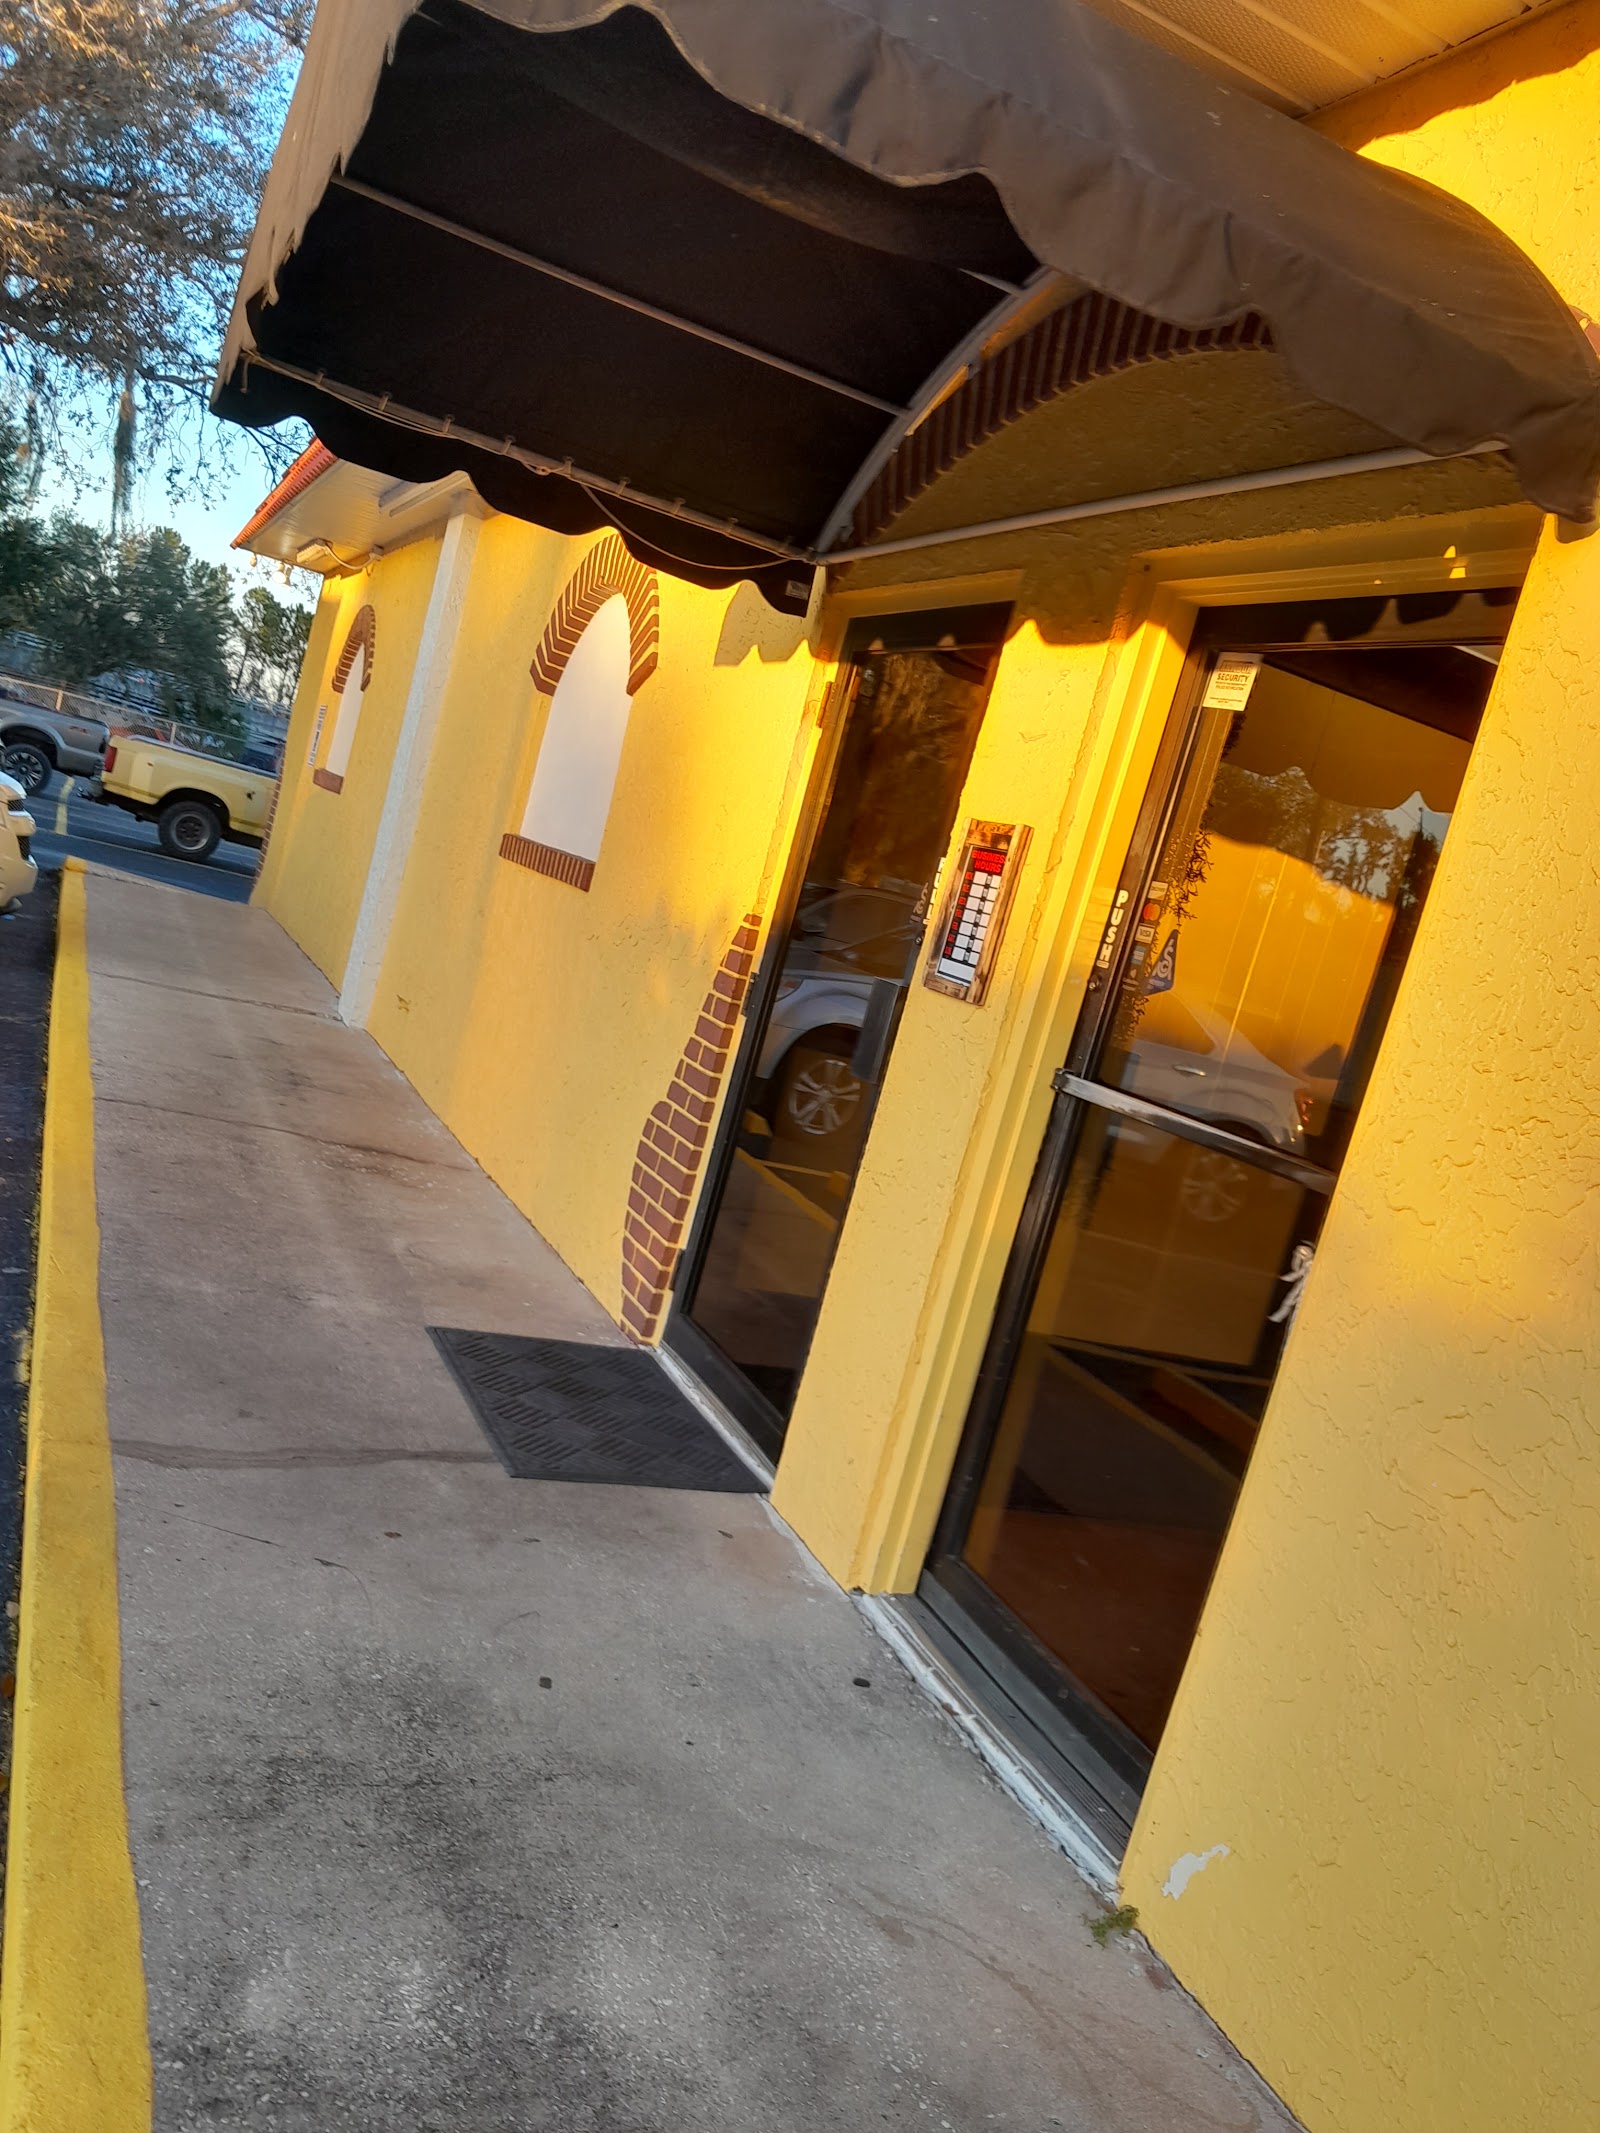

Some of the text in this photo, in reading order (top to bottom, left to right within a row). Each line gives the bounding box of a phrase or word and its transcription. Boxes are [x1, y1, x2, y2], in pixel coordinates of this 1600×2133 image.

[1217, 673, 1249, 682] SECURITY
[972, 850, 1006, 864] BUSINES
[974, 860, 1002, 873] HOURS
[1099, 889, 1129, 961] PUSH
